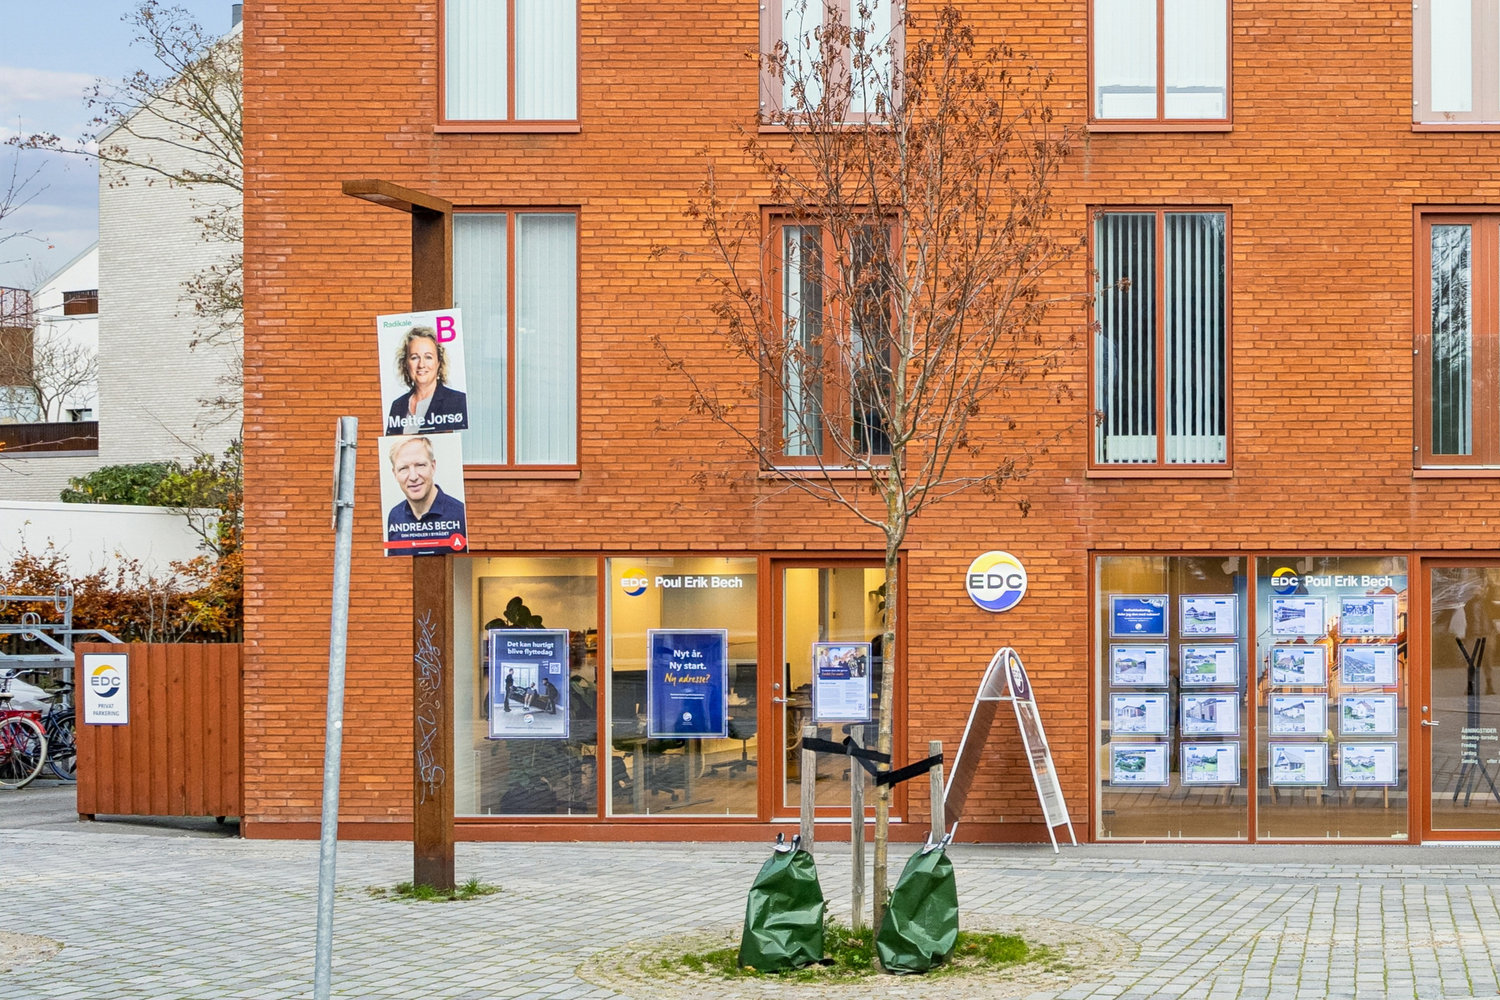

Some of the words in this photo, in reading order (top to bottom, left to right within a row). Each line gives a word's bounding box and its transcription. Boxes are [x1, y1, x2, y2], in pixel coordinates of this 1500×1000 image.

[383, 320, 412, 328] Radikale
[436, 316, 456, 343] B
[389, 415, 425, 428] Mette
[427, 412, 463, 425] Jorsø
[388, 521, 433, 532] ANDREAS
[434, 520, 461, 531] BECH
[454, 537, 462, 546] A
[620, 578, 649, 587] EDC
[655, 576, 681, 588] Poul
[684, 576, 708, 588] Erik
[711, 576, 743, 588] Bech
[969, 574, 1022, 589] EDC
[1271, 577, 1299, 586] EDC
[1305, 575, 1331, 587] Poul
[1334, 575, 1358, 587] Erik
[1361, 575, 1393, 587] Bech
[532, 641, 554, 649] hurtigt
[524, 648, 553, 656] flyttedag
[673, 649, 689, 659] Nyt
[691, 649, 703, 658] år.
[669, 661, 682, 671] Ny
[683, 662, 707, 670] start.
[91, 677, 121, 686] EDC
[664, 672, 677, 687] Ny
[678, 673, 711, 684] adresse?
